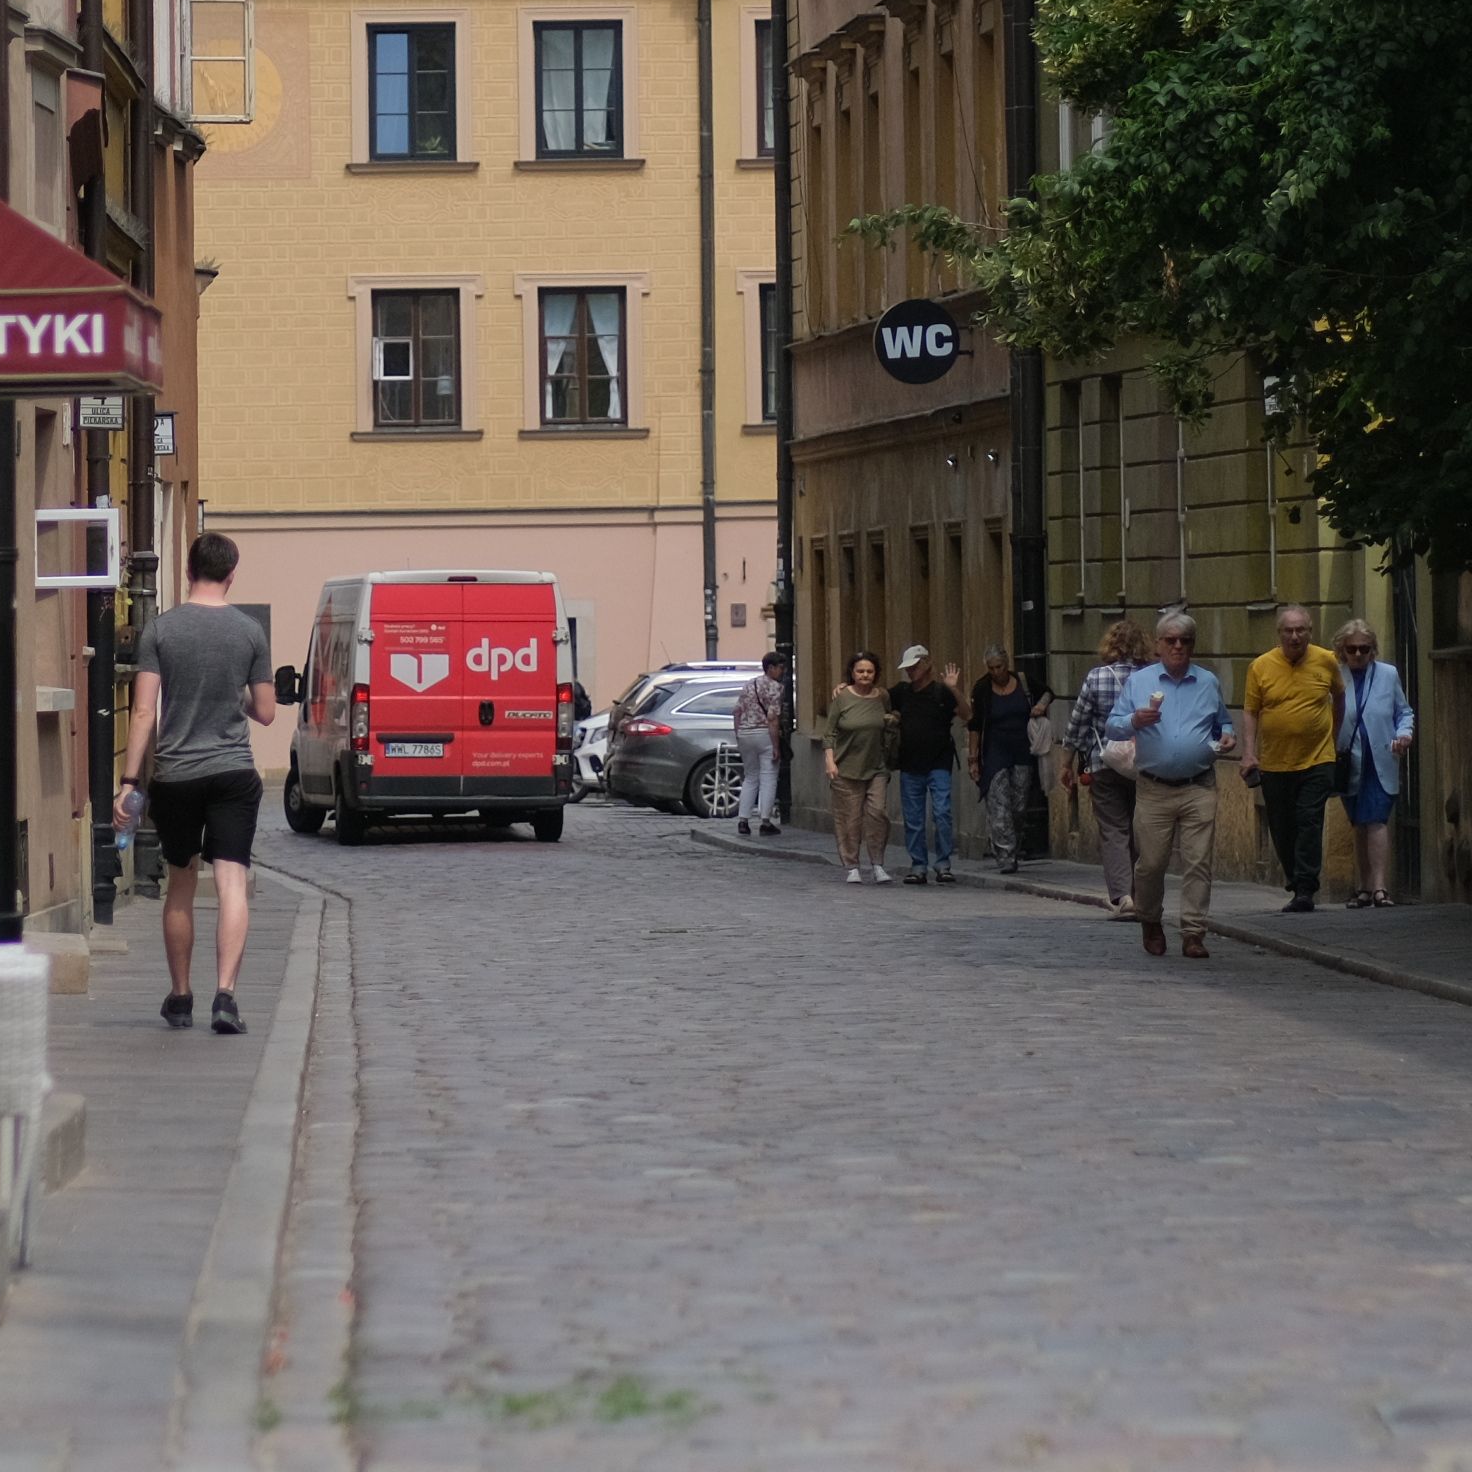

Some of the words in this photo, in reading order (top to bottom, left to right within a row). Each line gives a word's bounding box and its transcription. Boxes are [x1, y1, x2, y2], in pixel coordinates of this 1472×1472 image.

[881, 323, 953, 359] WC
[83, 416, 119, 424] PIEKARSKA
[466, 637, 537, 680] dpd
[507, 711, 551, 719] DUCATO
[490, 751, 516, 760] delivery
[518, 752, 543, 760] experts
